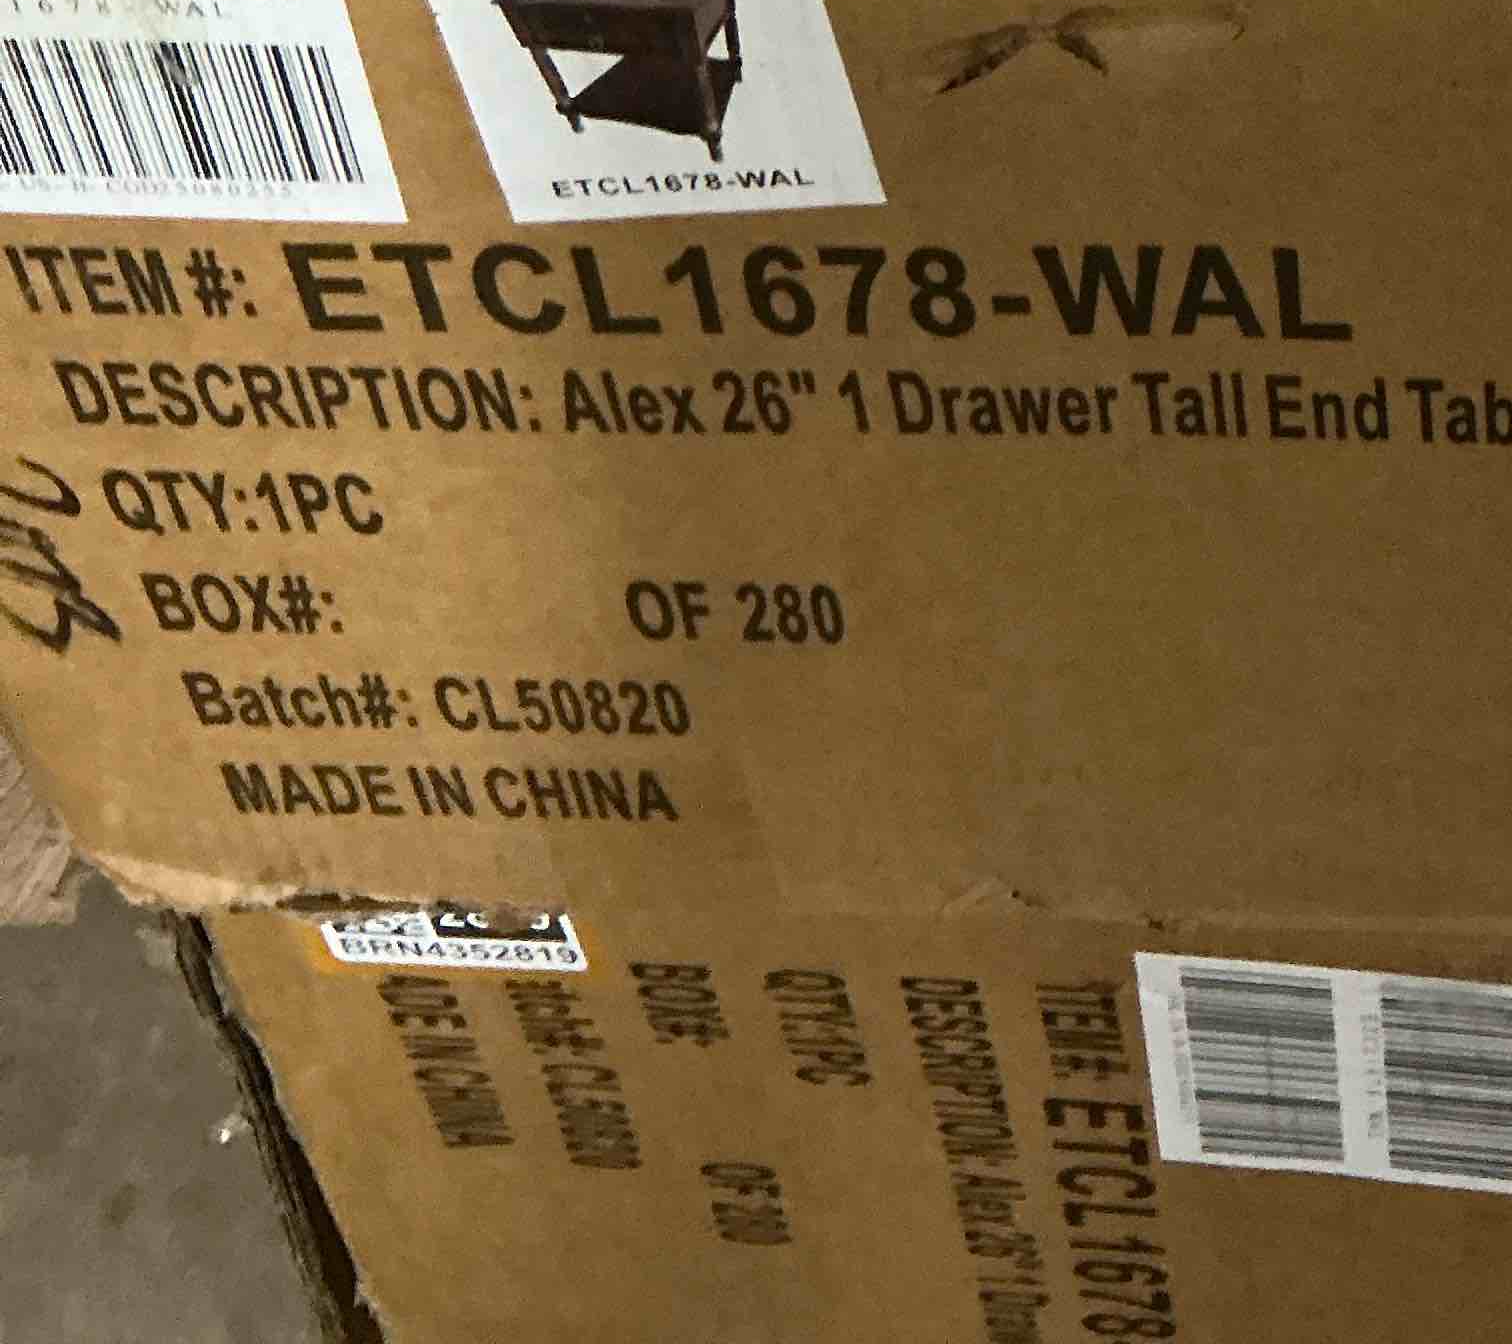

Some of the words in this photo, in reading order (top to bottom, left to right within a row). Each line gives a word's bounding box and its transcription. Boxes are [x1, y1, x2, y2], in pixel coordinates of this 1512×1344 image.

[552, 168, 815, 198] ETCL1678-WAL
[4, 246, 182, 315] ITEM
[282, 242, 1353, 341] ETCL1678-WAL
[54, 361, 540, 434] DESCRIPTION:
[563, 368, 707, 434] Alex
[712, 368, 816, 434] 26"
[838, 369, 870, 434] 1
[888, 369, 1118, 436] Drawer
[1131, 370, 1248, 439] Tall
[1265, 374, 1390, 441] End
[102, 468, 384, 537] QTY:1PC
[140, 572, 345, 635] BOX#:
[625, 580, 710, 642] OF
[735, 582, 845, 645] 280
[181, 670, 418, 729] Batch#:
[433, 675, 691, 736] CL50820
[219, 761, 398, 817] MADE
[407, 764, 474, 817] IN
[486, 767, 679, 820] CHINA
[376, 973, 468, 1028] ADE
[504, 978, 605, 1058] atch#:
[900, 977, 1019, 1168] DESCRIPTION:
[1043, 1097, 1178, 1344] ETCL1678
